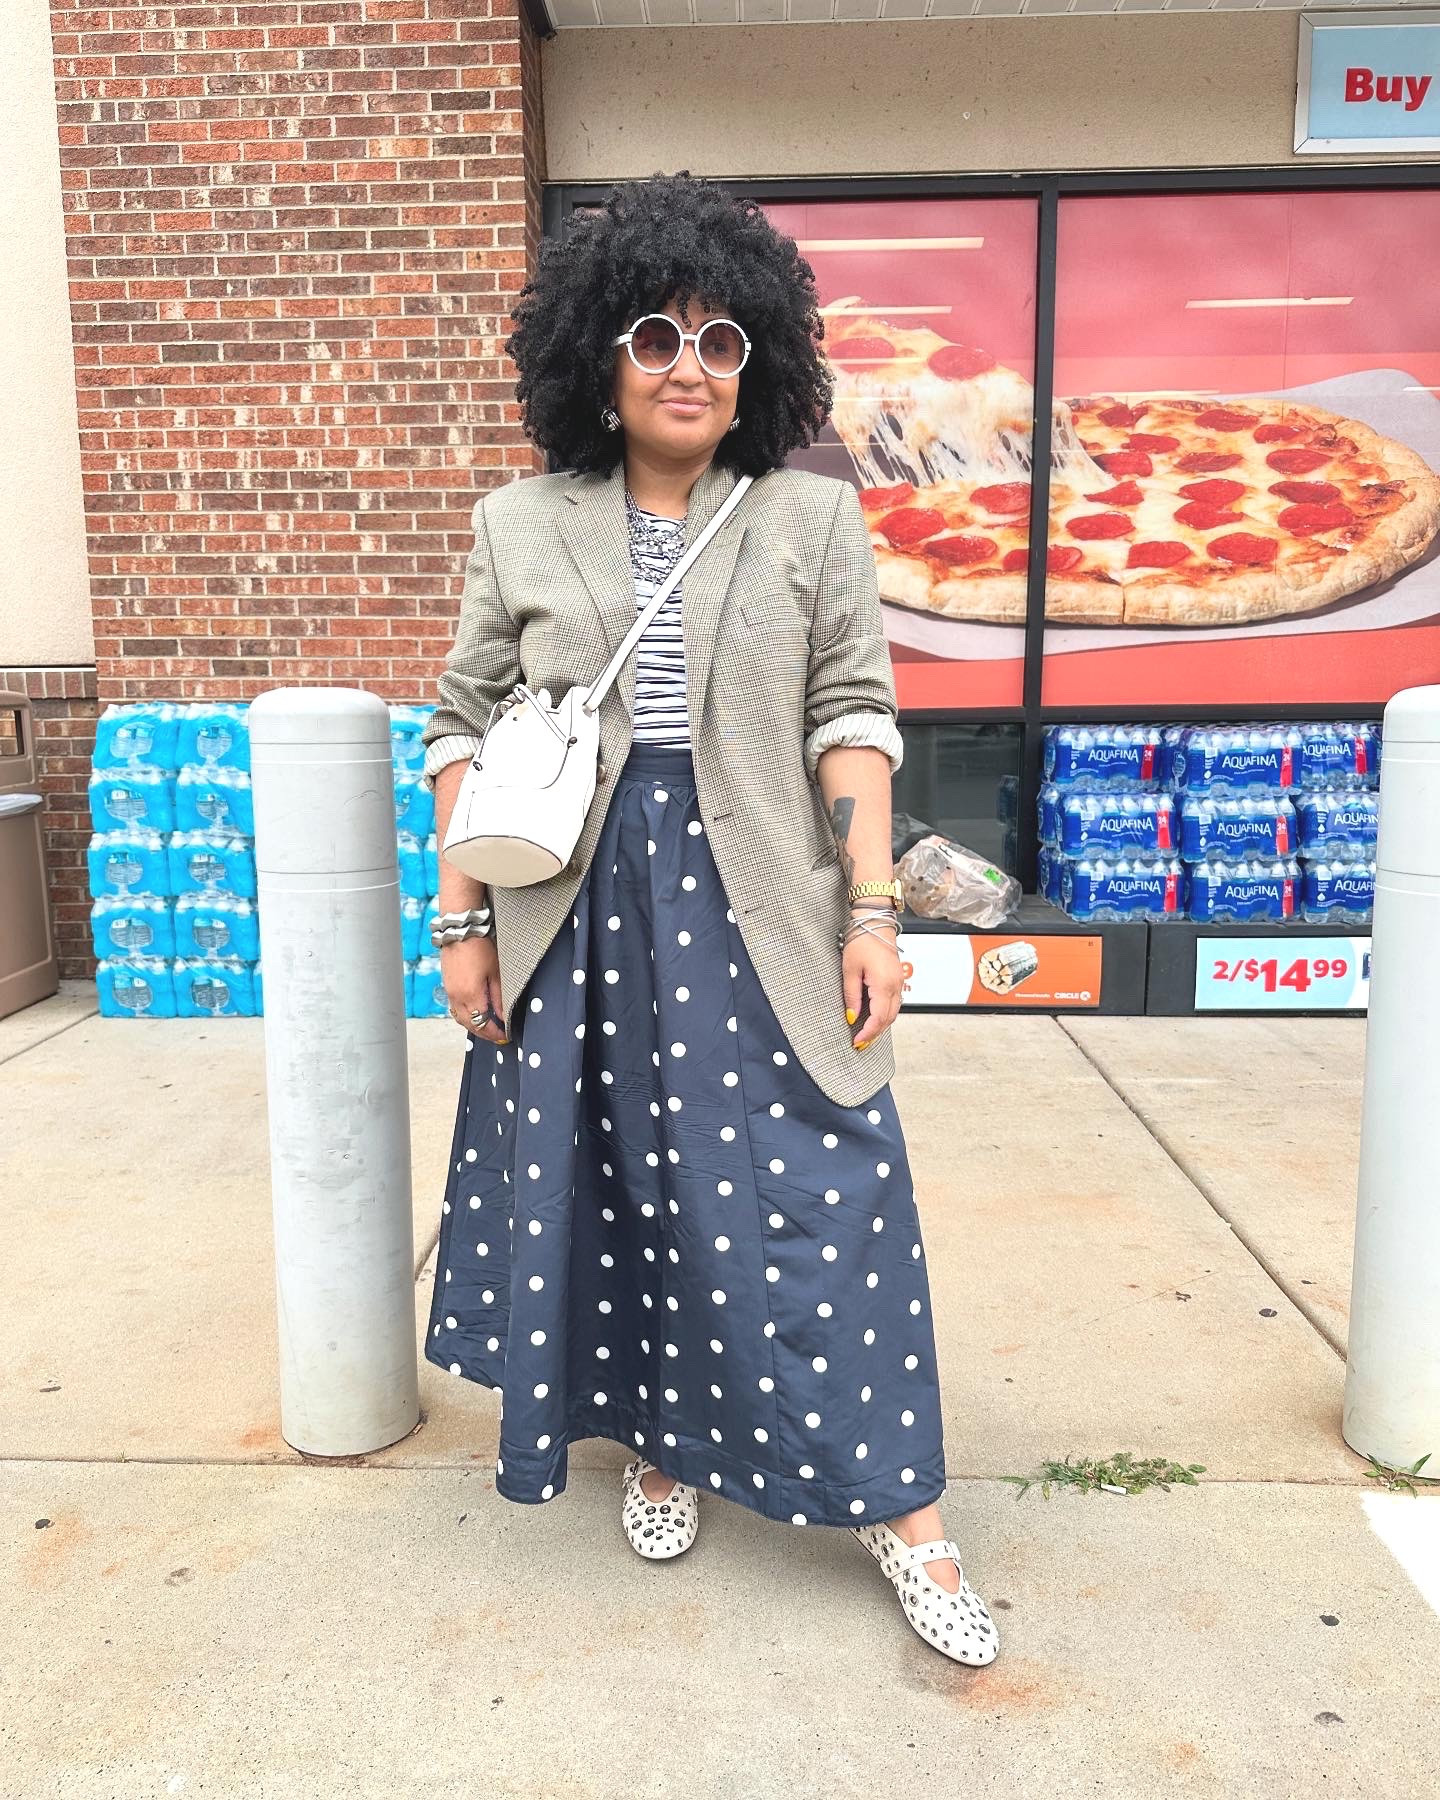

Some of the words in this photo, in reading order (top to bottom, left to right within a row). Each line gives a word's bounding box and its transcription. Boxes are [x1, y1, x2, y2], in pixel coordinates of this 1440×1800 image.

[1344, 67, 1433, 112] Buy
[1088, 749, 1139, 763] AQUAFINA
[1222, 754, 1278, 769] AQUAFINA
[1100, 817, 1154, 832] AQUAFINA
[1335, 813, 1378, 825] AQUAFIN
[1217, 823, 1272, 837] AQUAFINA
[1107, 880, 1161, 894] AQUAFINA
[1225, 885, 1279, 900] AQUAFINA
